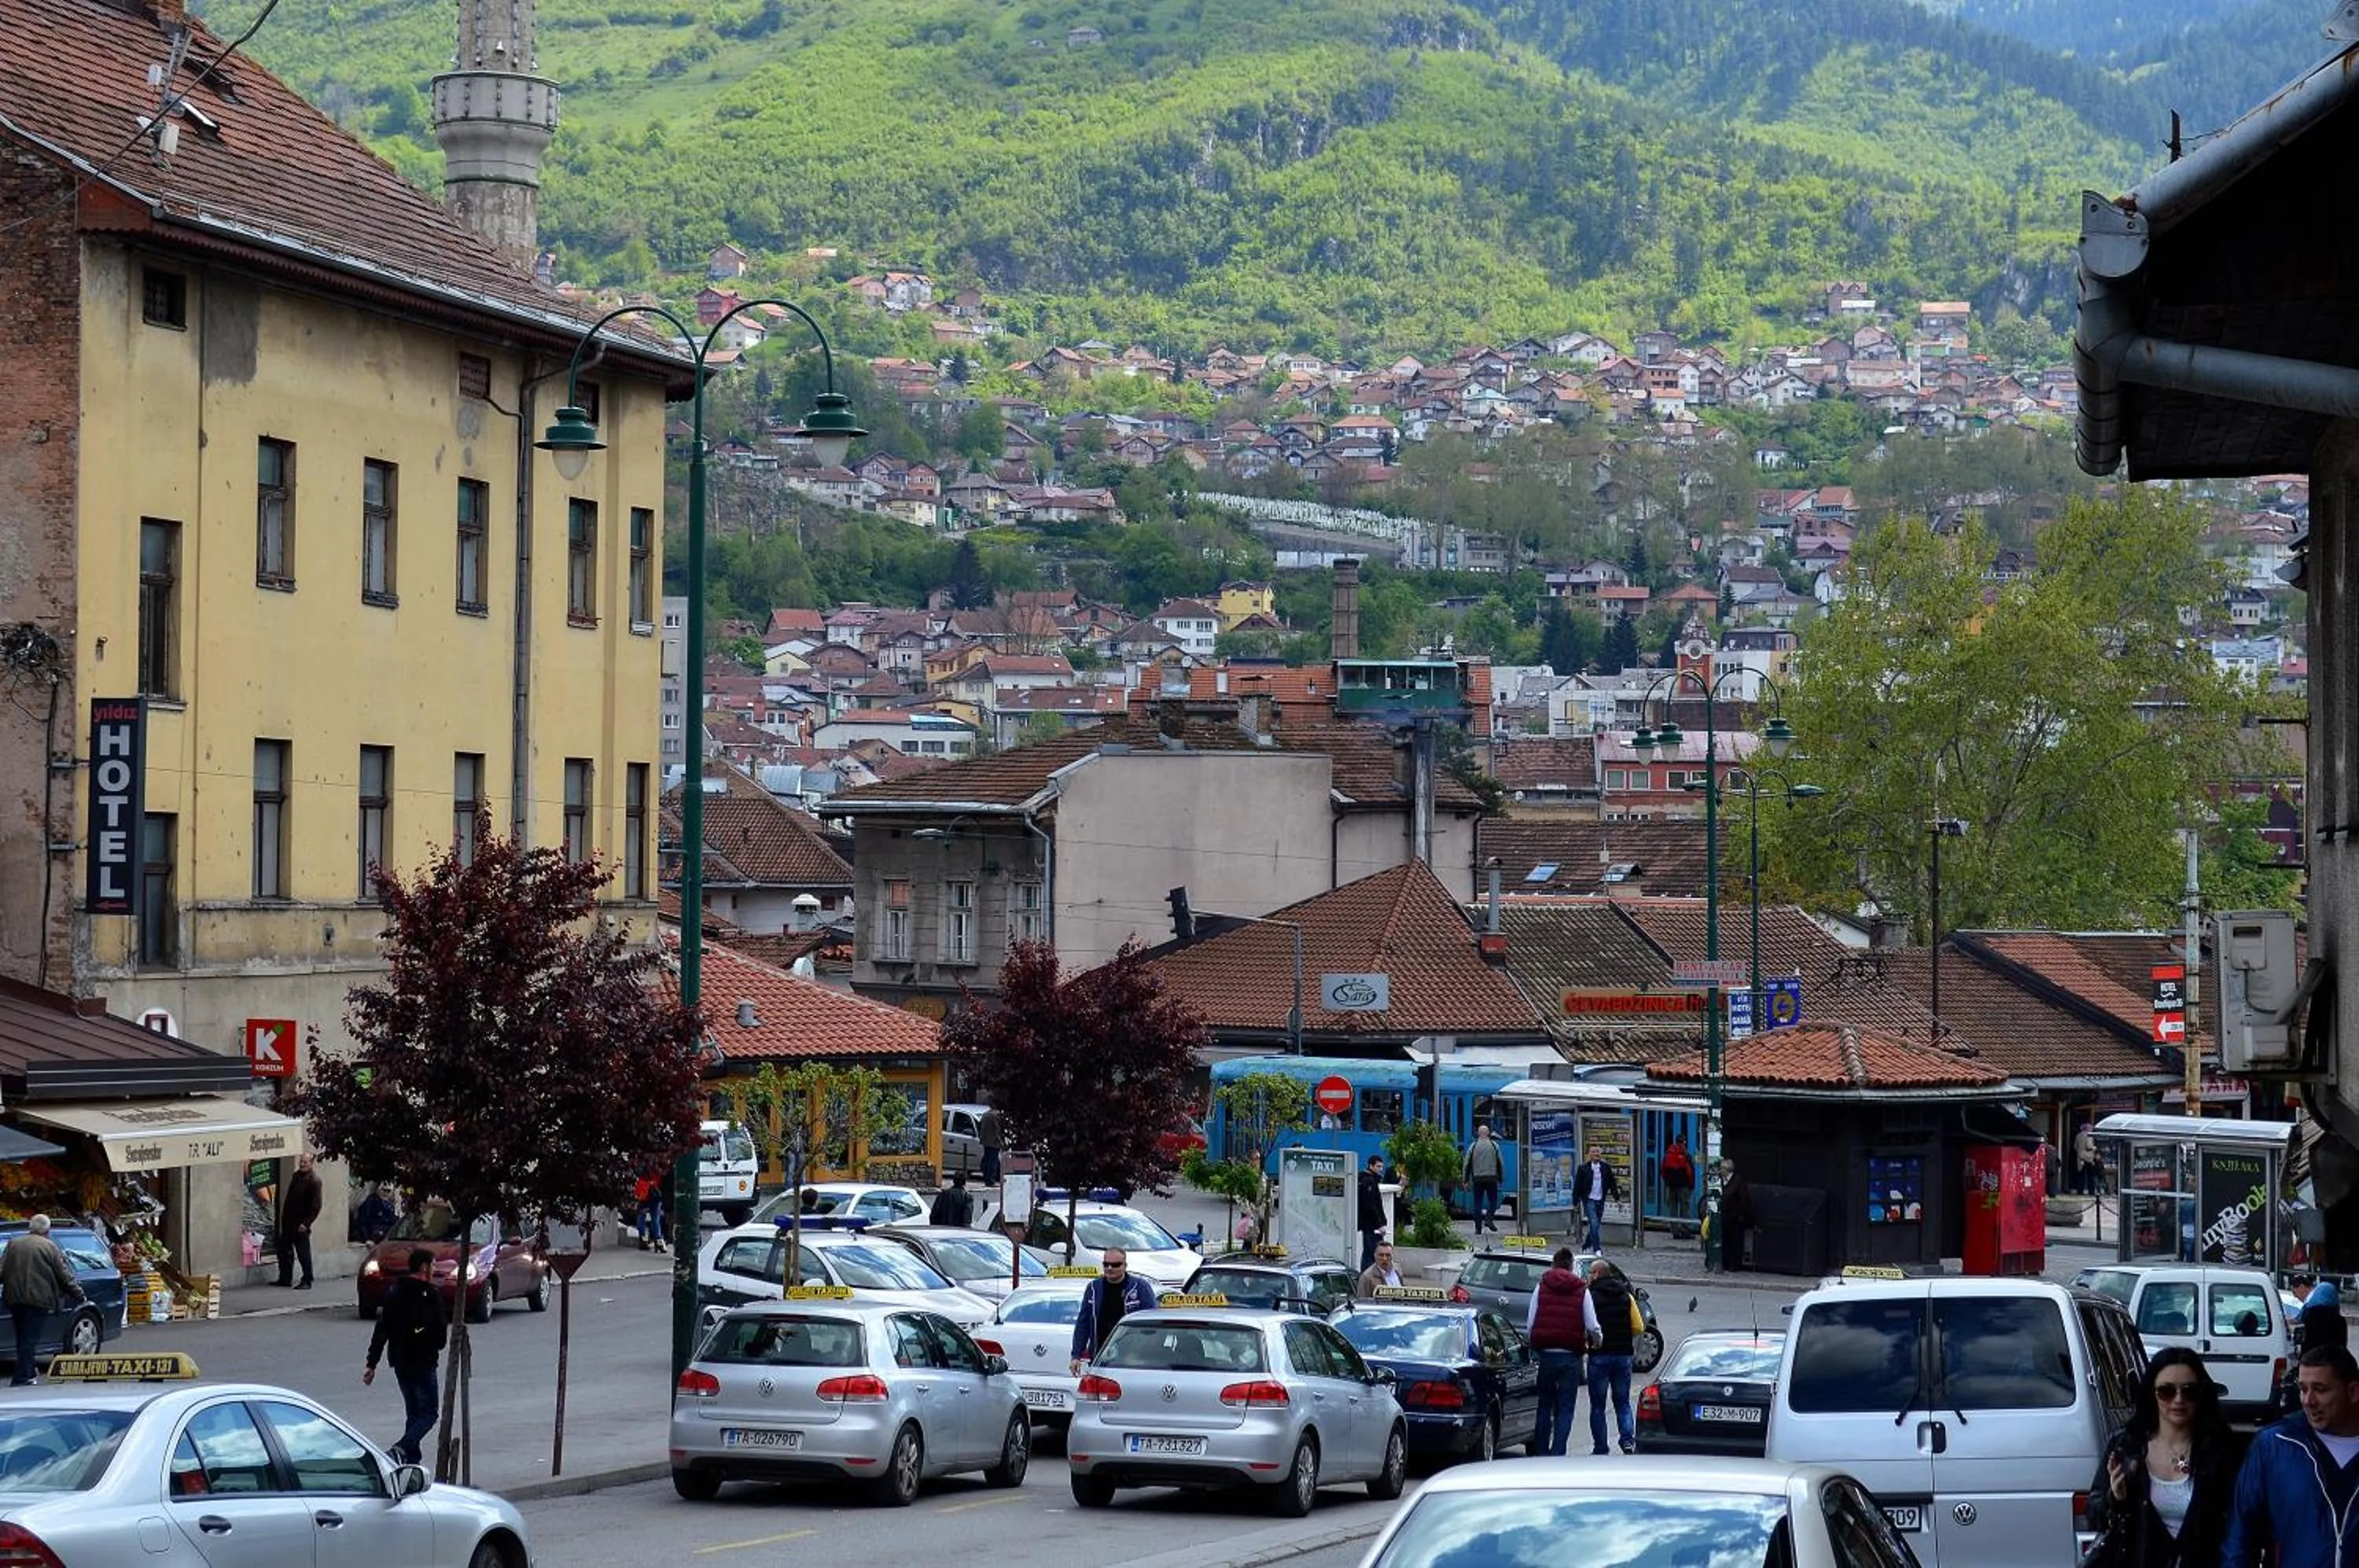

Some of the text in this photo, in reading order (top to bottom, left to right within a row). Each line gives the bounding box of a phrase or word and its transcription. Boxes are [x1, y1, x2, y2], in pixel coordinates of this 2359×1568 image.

[98, 724, 131, 898] HOTEL
[1676, 961, 1742, 973] RENT-A-CAR
[1310, 1160, 1335, 1172] TAXI
[2203, 1183, 2267, 1253] nyBook
[1140, 1437, 1202, 1452] TA-731327
